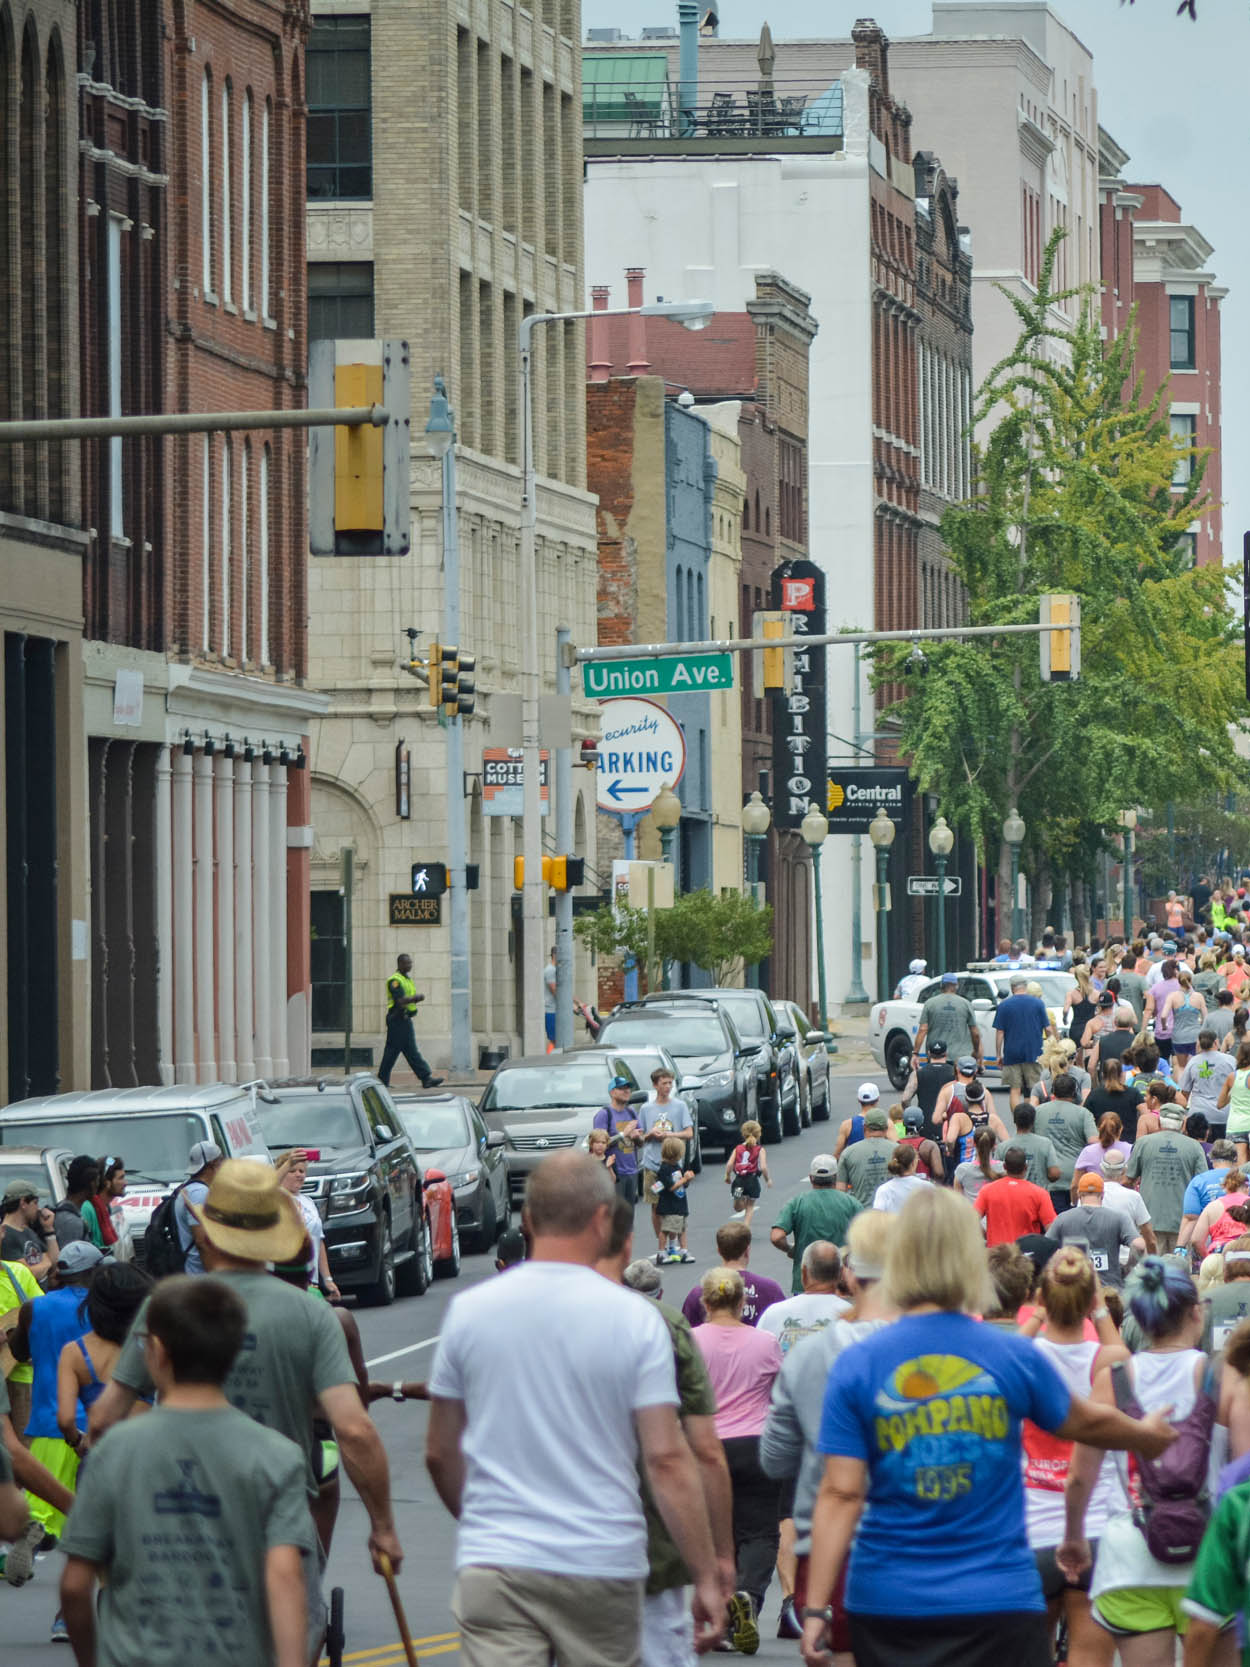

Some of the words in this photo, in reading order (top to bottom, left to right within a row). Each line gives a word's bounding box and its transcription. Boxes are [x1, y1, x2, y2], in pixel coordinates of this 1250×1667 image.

[589, 667, 659, 691] Union
[671, 663, 726, 686] Ave.
[604, 715, 659, 741] ecurity
[486, 763, 546, 773] COTTN
[596, 751, 673, 774] ARKING
[486, 774, 546, 784] MUSEM
[846, 785, 902, 800] Central
[392, 899, 438, 910] ARCHER
[393, 909, 438, 920] MALMO
[875, 1394, 1008, 1452] POMPANO
